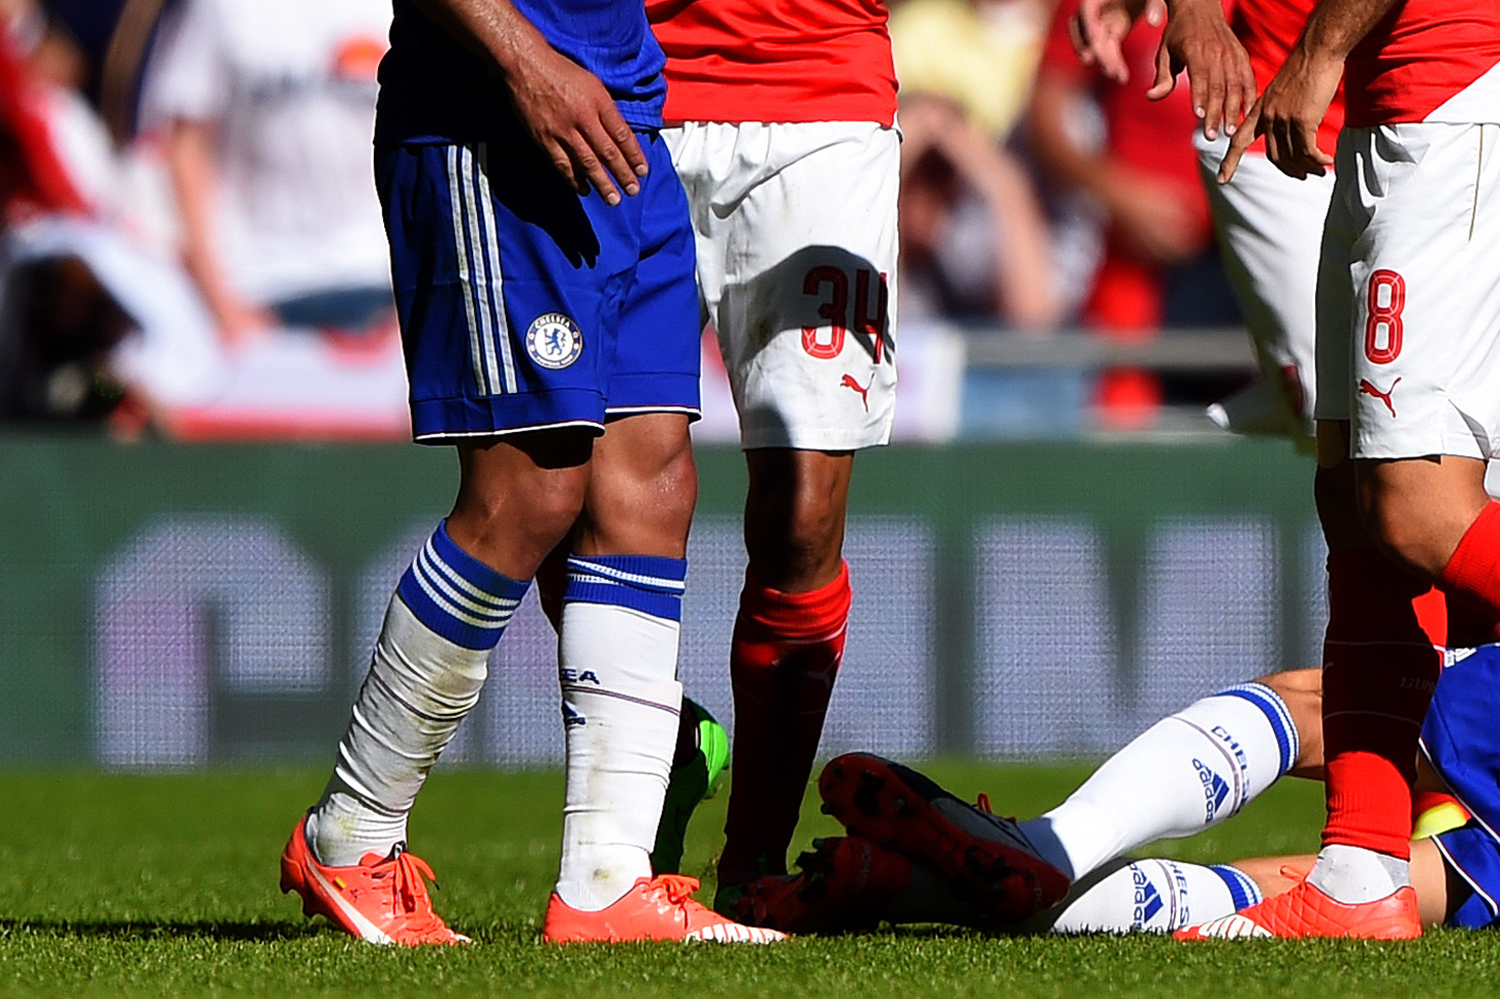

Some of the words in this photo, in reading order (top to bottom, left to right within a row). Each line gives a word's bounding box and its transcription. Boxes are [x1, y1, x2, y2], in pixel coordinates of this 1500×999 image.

[801, 265, 888, 365] 34
[1365, 268, 1407, 364] 8
[560, 668, 600, 684] EA
